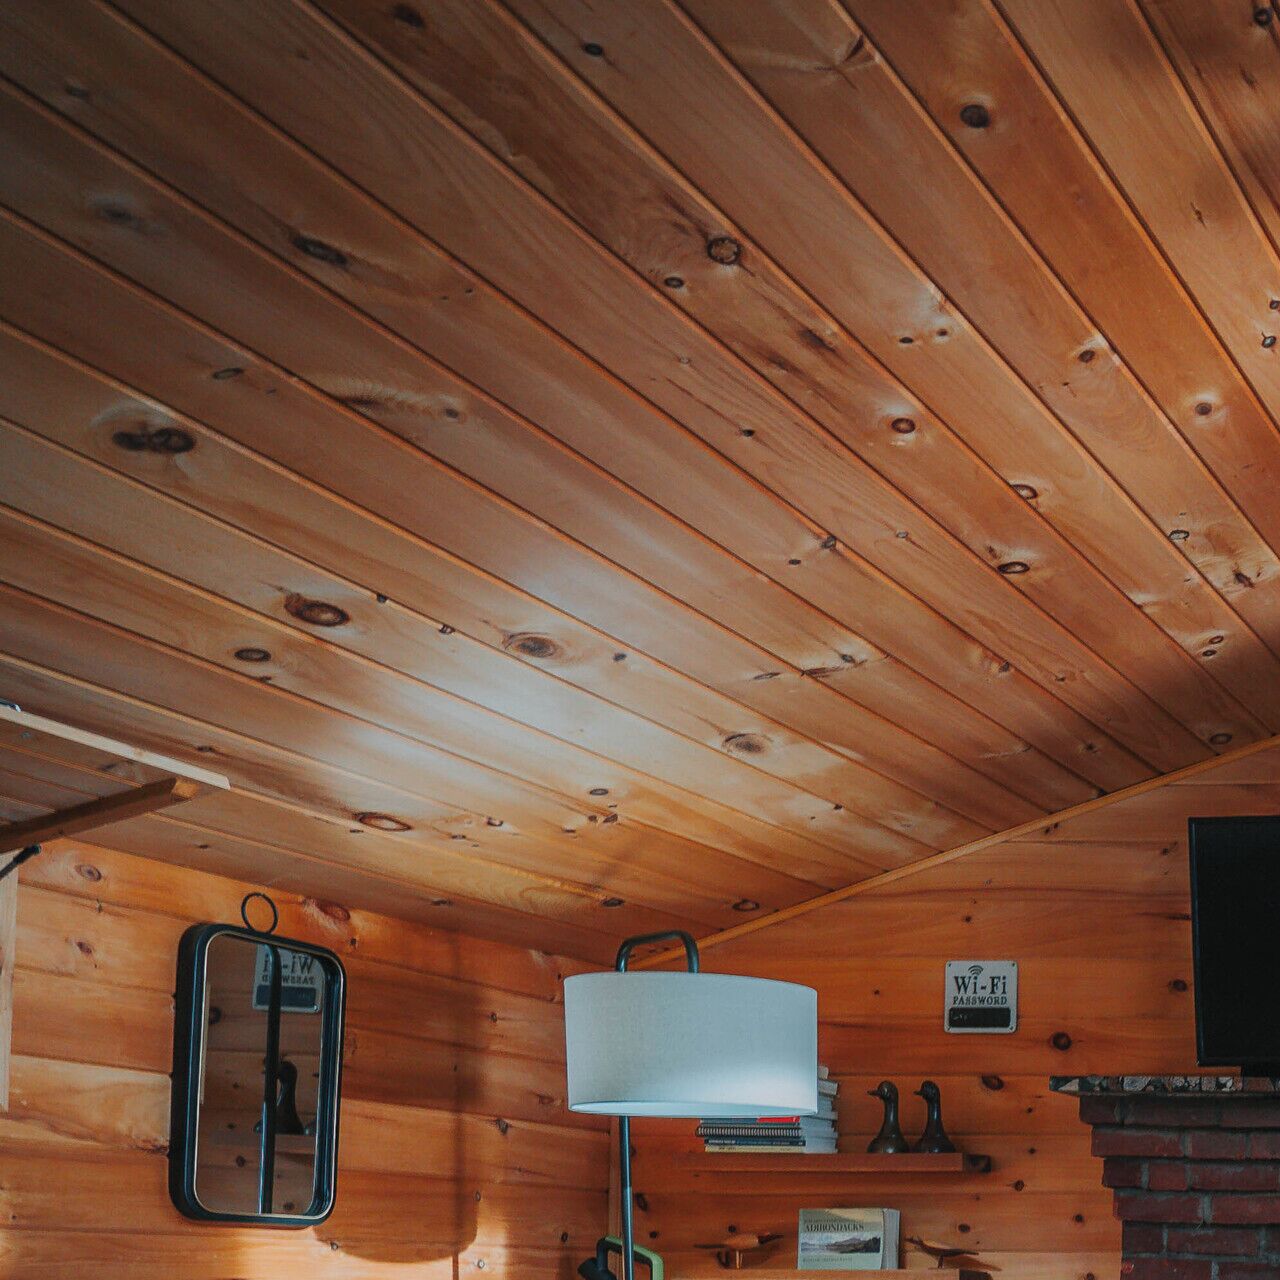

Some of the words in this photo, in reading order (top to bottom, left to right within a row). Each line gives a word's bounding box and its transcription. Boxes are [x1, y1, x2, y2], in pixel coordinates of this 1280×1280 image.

[954, 975, 1007, 995] Wi-Fi
[952, 995, 1008, 1006] PASSWORD
[805, 1222, 864, 1232] ADIRONDACKS
